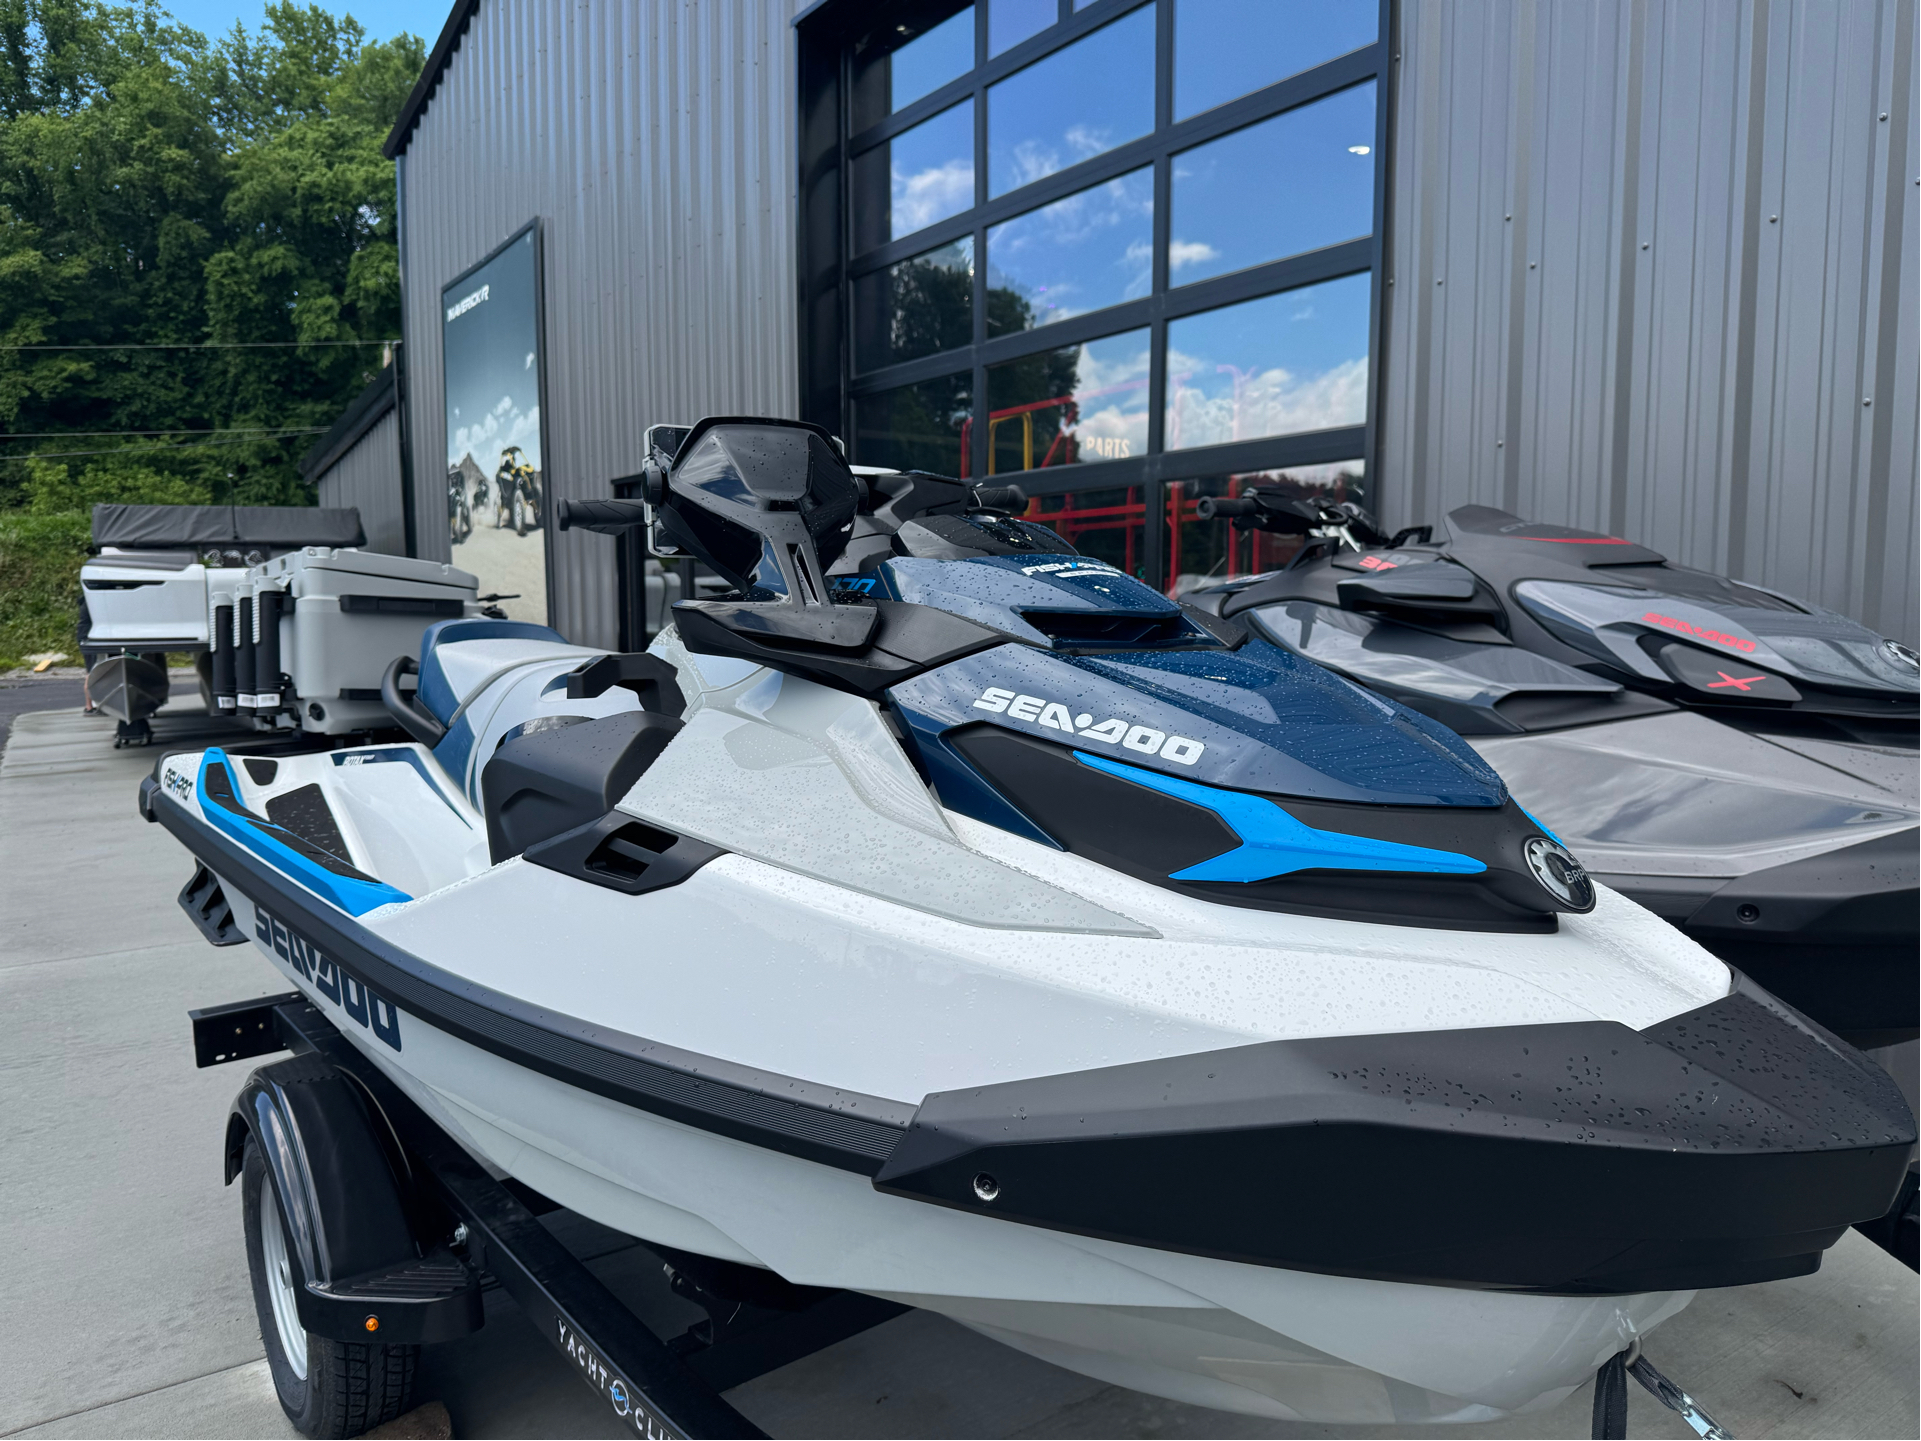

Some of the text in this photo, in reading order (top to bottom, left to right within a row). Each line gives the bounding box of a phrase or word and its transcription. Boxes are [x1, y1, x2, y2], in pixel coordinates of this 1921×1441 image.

[1086, 435, 1130, 459] PARTS
[558, 1319, 671, 1440] YACHT CL
